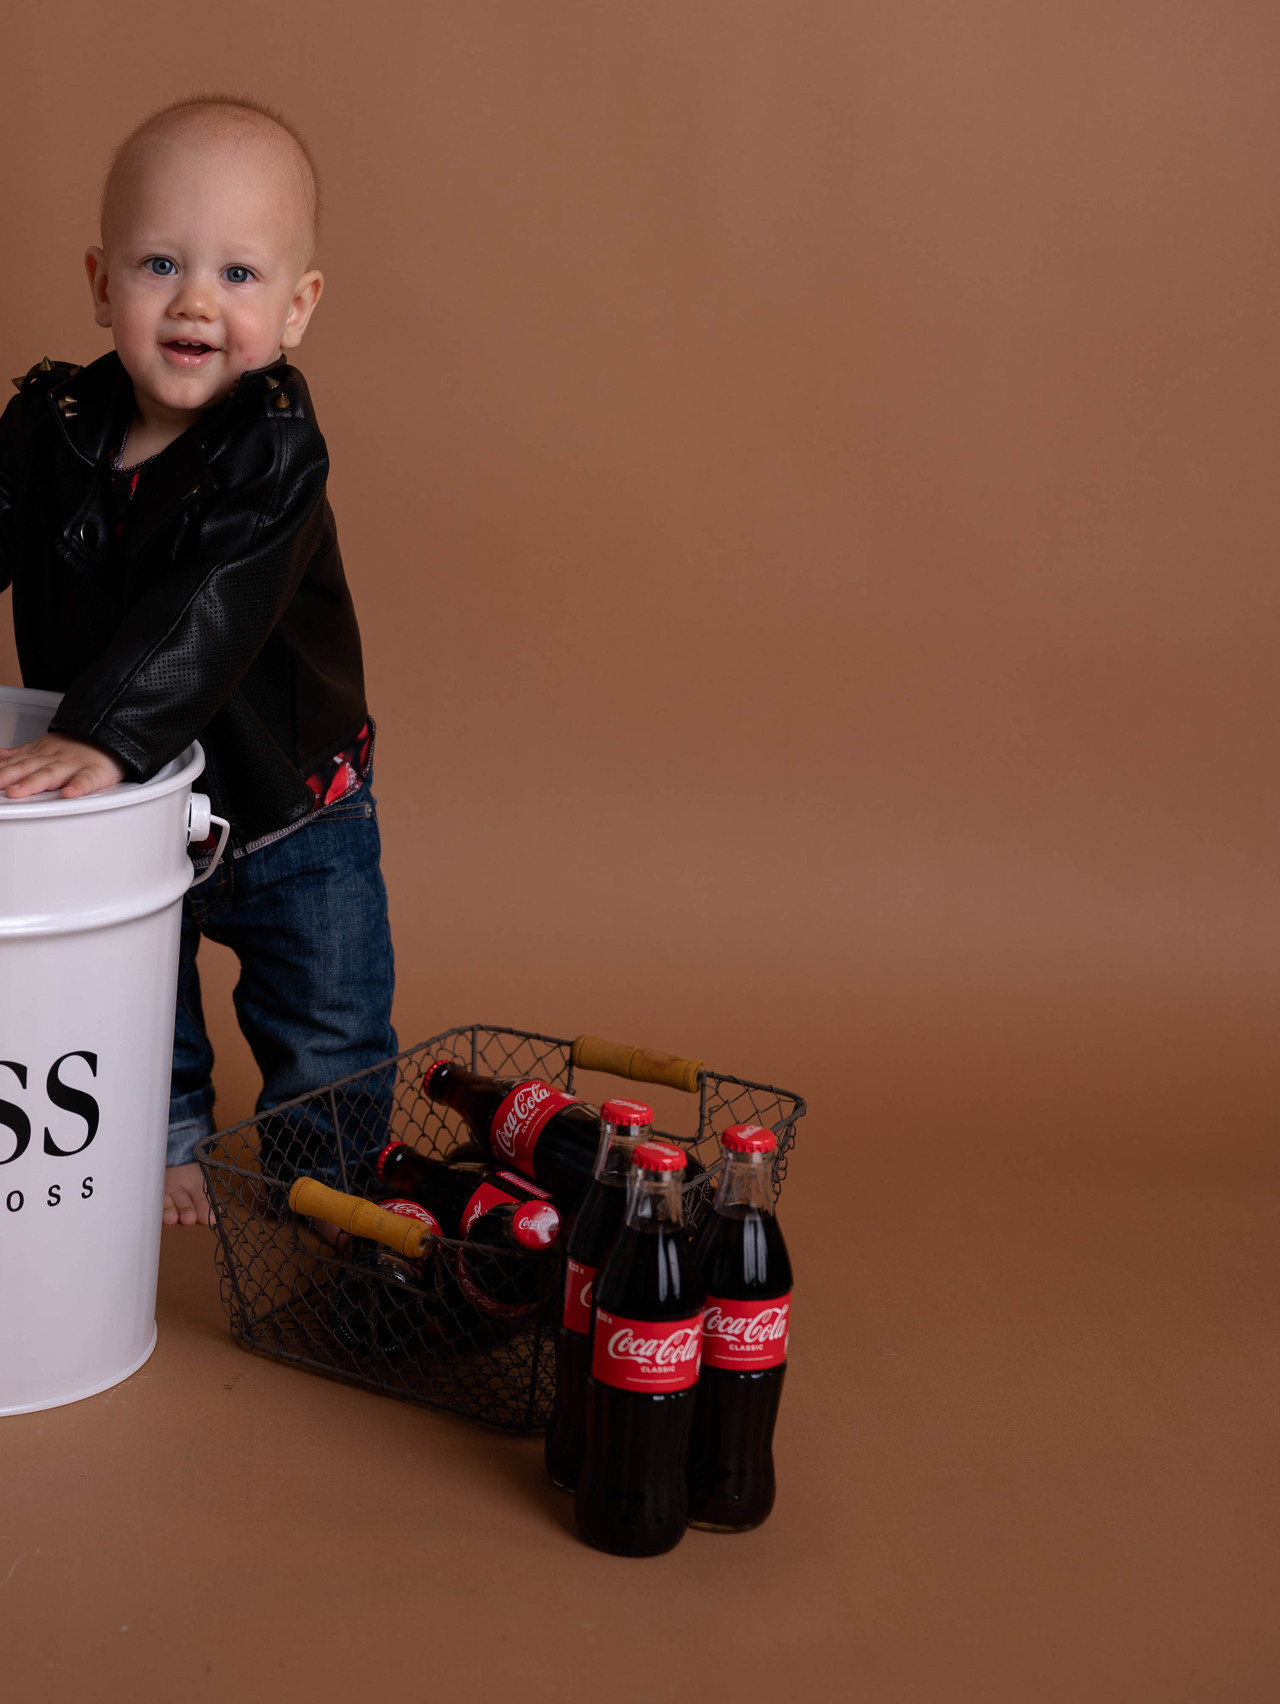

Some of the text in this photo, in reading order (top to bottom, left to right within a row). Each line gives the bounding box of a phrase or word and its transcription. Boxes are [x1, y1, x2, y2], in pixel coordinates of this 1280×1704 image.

[496, 1083, 550, 1157] Coca-Cola
[521, 1107, 540, 1133] CLASSIC
[703, 1304, 788, 1343] Coca-Cola
[607, 1324, 700, 1365] Coca-Cola
[728, 1344, 764, 1352] CLASSIC
[640, 1365, 676, 1374] CLASSIC
